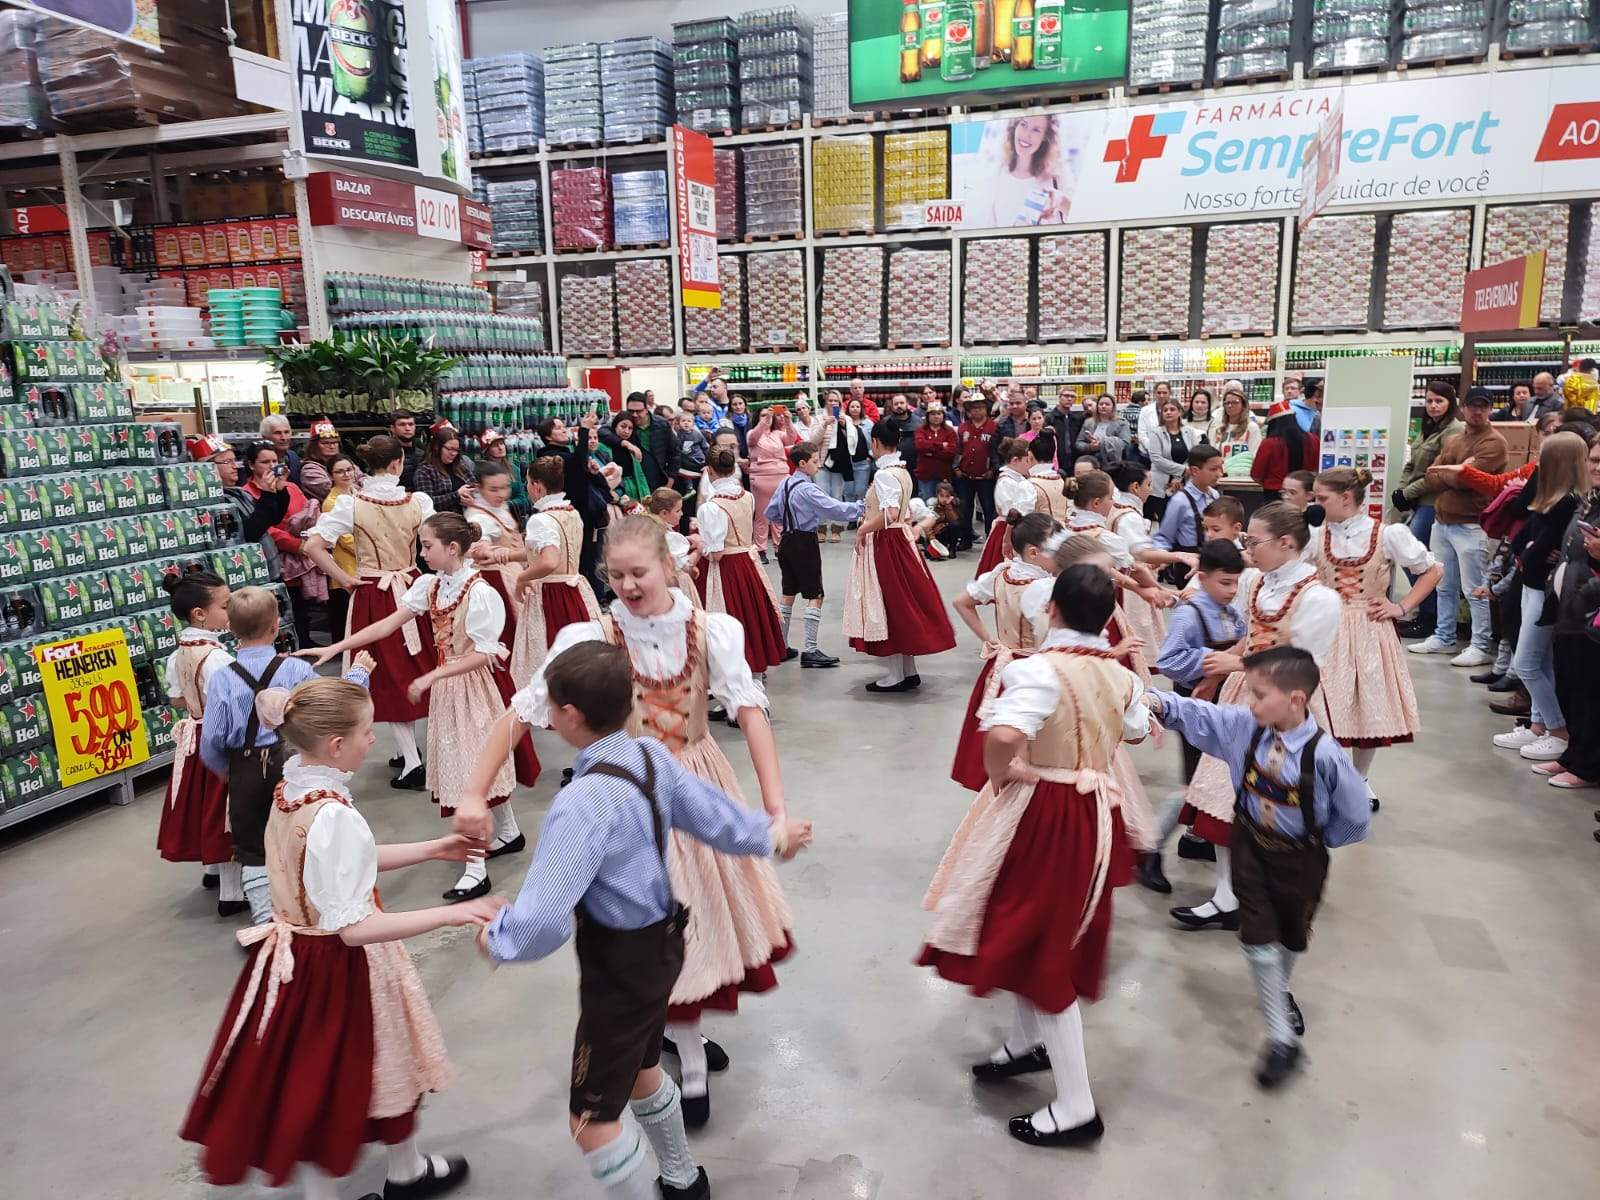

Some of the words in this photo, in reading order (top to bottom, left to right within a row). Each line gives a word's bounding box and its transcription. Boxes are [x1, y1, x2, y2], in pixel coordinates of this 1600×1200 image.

[1196, 95, 1330, 125] FARMÁCIA
[336, 180, 371, 195] BAZAR
[1184, 190, 1247, 210] Nosso
[1250, 185, 1302, 210] forte
[1404, 175, 1431, 196] de
[1438, 169, 1490, 193] você
[674, 131, 691, 282] OPORTUNIDADES
[341, 207, 414, 227] DESCARTÁVEIS
[1474, 281, 1519, 311] TELEVENDAS
[21, 324, 42, 336] Hei
[29, 365, 49, 376] Hei
[59, 364, 79, 376] Hei
[88, 406, 107, 418] Hei
[74, 451, 93, 462] Hei
[137, 447, 155, 459] Hei
[19, 455, 40, 468] Hei
[117, 495, 137, 509] Hei
[181, 489, 199, 501] Hei
[54, 503, 76, 517] Hei
[159, 536, 178, 550] Hei
[98, 546, 119, 560] Hei
[33, 557, 54, 572] Hei
[229, 571, 246, 585] Hei
[60, 604, 82, 619] Hei
[157, 634, 176, 650] Hei
[43, 641, 83, 663] Fort
[54, 648, 117, 681] HEINEKEN
[15, 724, 40, 744] Hei
[19, 775, 45, 796] Hei
